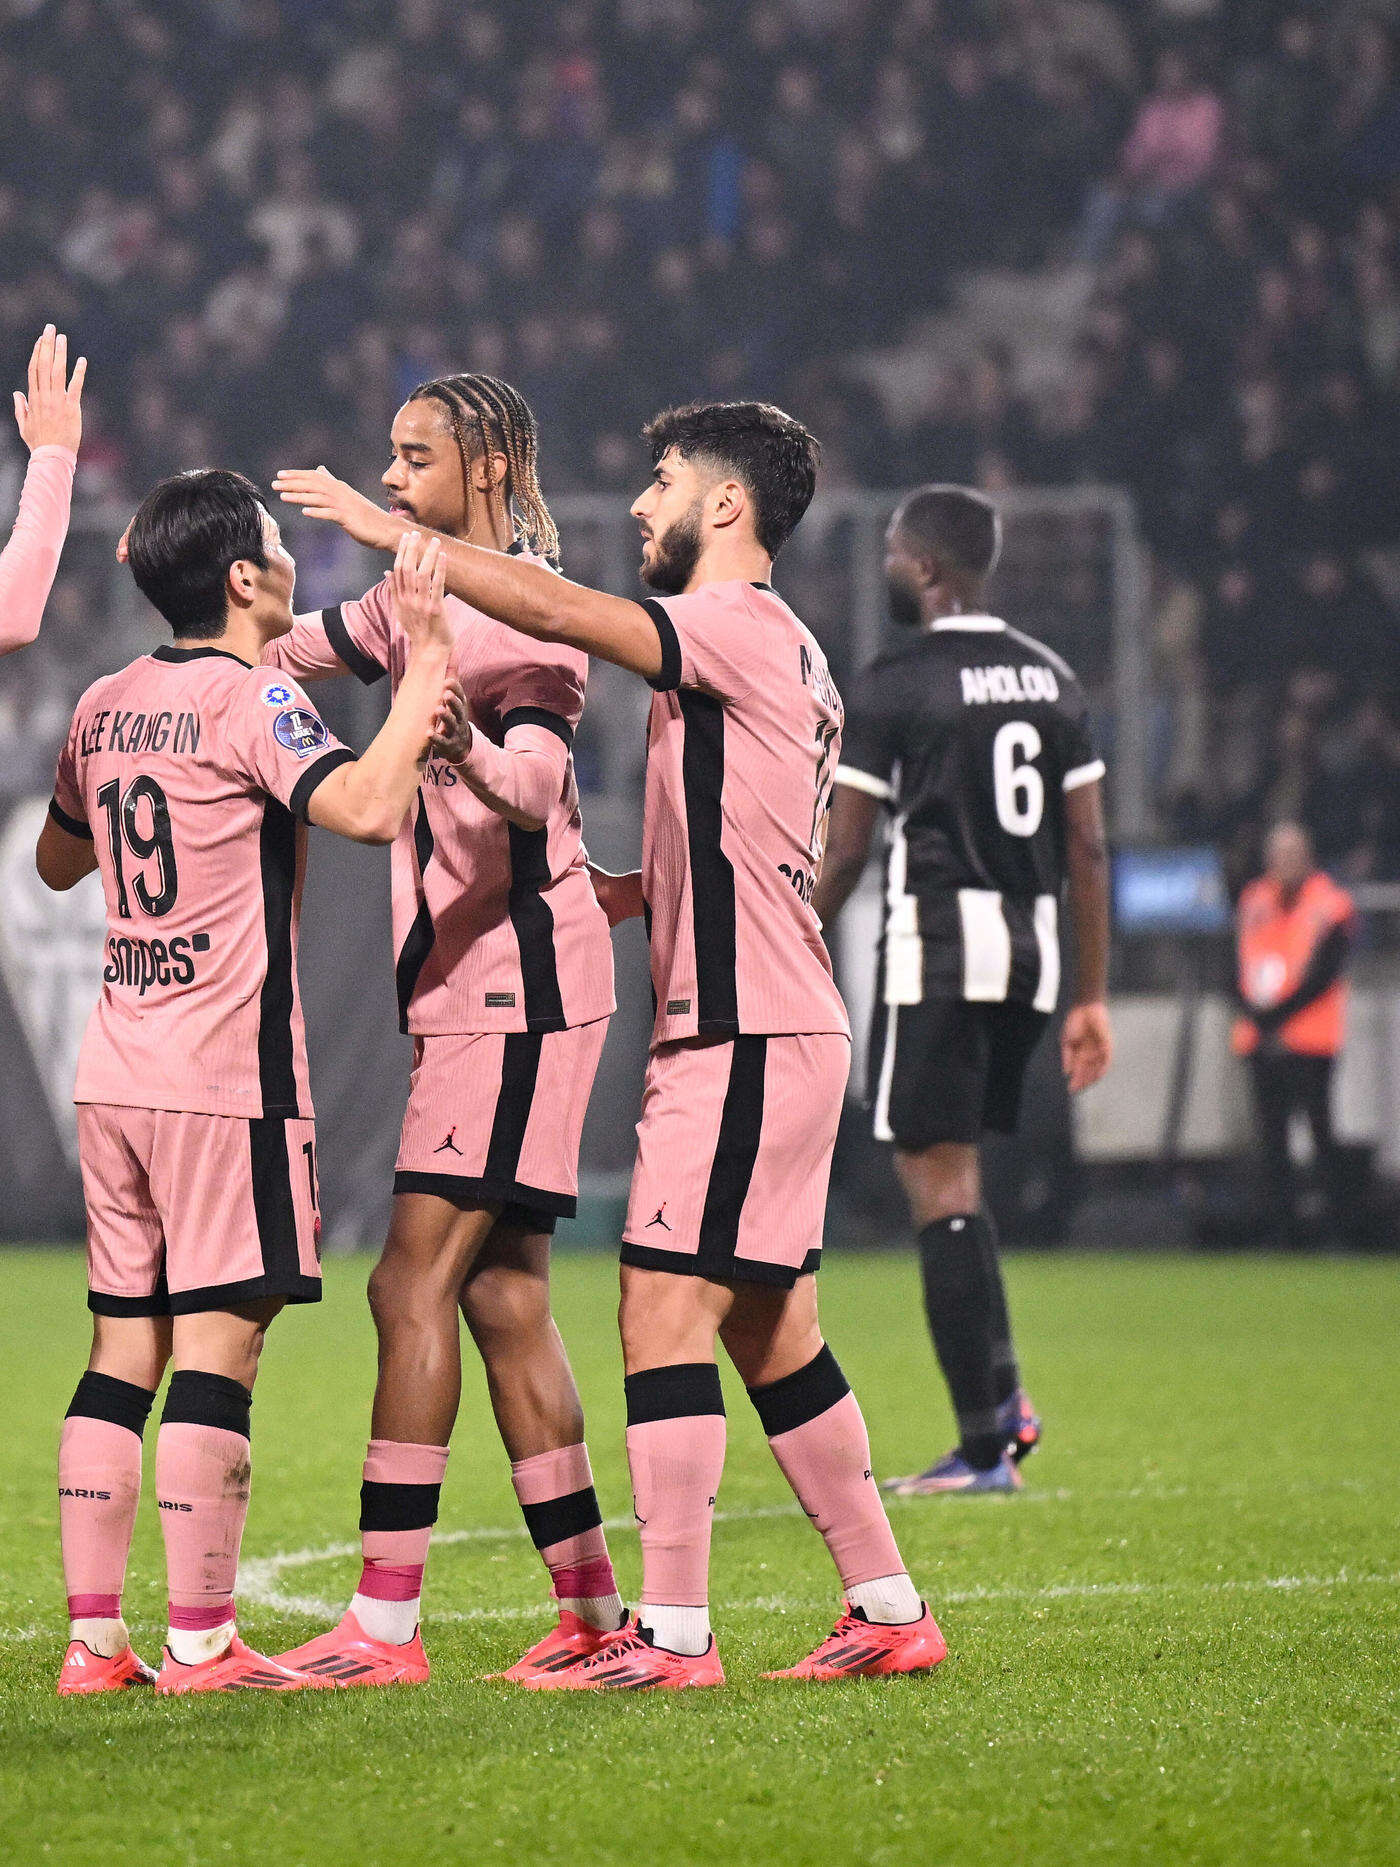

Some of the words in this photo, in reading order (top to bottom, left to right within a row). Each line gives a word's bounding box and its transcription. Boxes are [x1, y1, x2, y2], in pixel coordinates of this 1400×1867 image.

[81, 711, 111, 757] LEE
[108, 711, 173, 753] KANG
[173, 712, 200, 754] IN
[993, 720, 1045, 838] 6
[97, 775, 178, 920] 19
[103, 935, 195, 996] snipes
